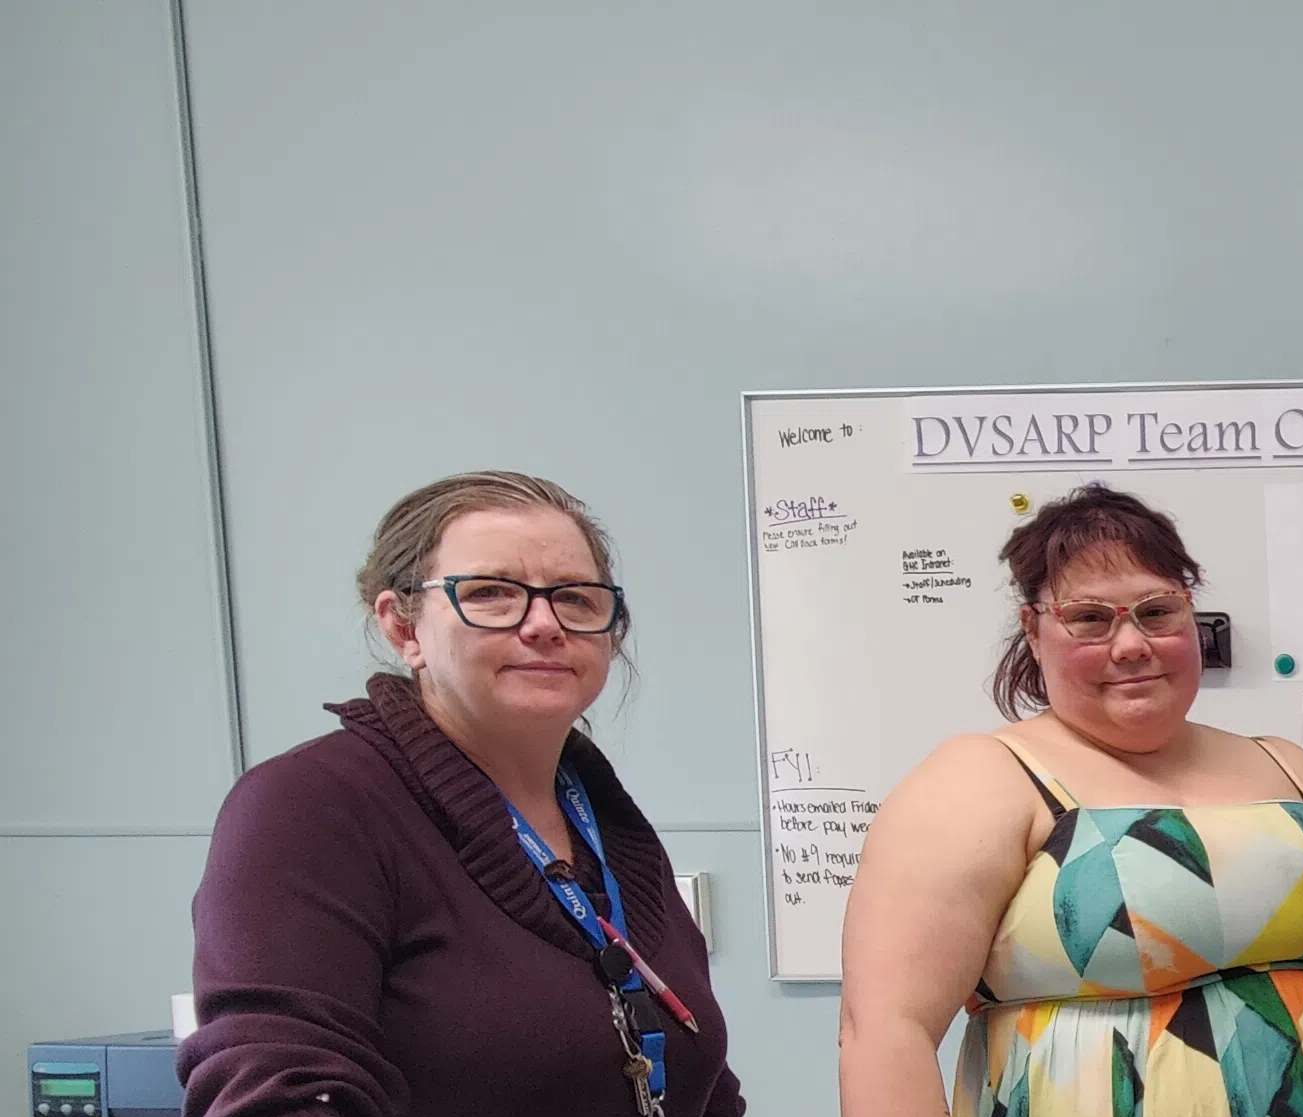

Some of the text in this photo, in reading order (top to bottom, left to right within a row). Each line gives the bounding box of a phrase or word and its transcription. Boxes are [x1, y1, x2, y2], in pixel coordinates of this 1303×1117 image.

[778, 427, 834, 448] Welcome
[911, 413, 1113, 458] DVSARP
[1127, 411, 1260, 454] Team
[788, 528, 813, 538] ensure
[843, 519, 857, 532] out
[902, 549, 946, 560] Available on
[777, 800, 805, 813] Hours
[808, 801, 846, 814] emailed
[780, 815, 818, 832] before
[823, 820, 847, 838] pay
[781, 843, 796, 864] No
[826, 852, 861, 868] requir
[782, 869, 792, 884] to
[796, 870, 821, 884] send
